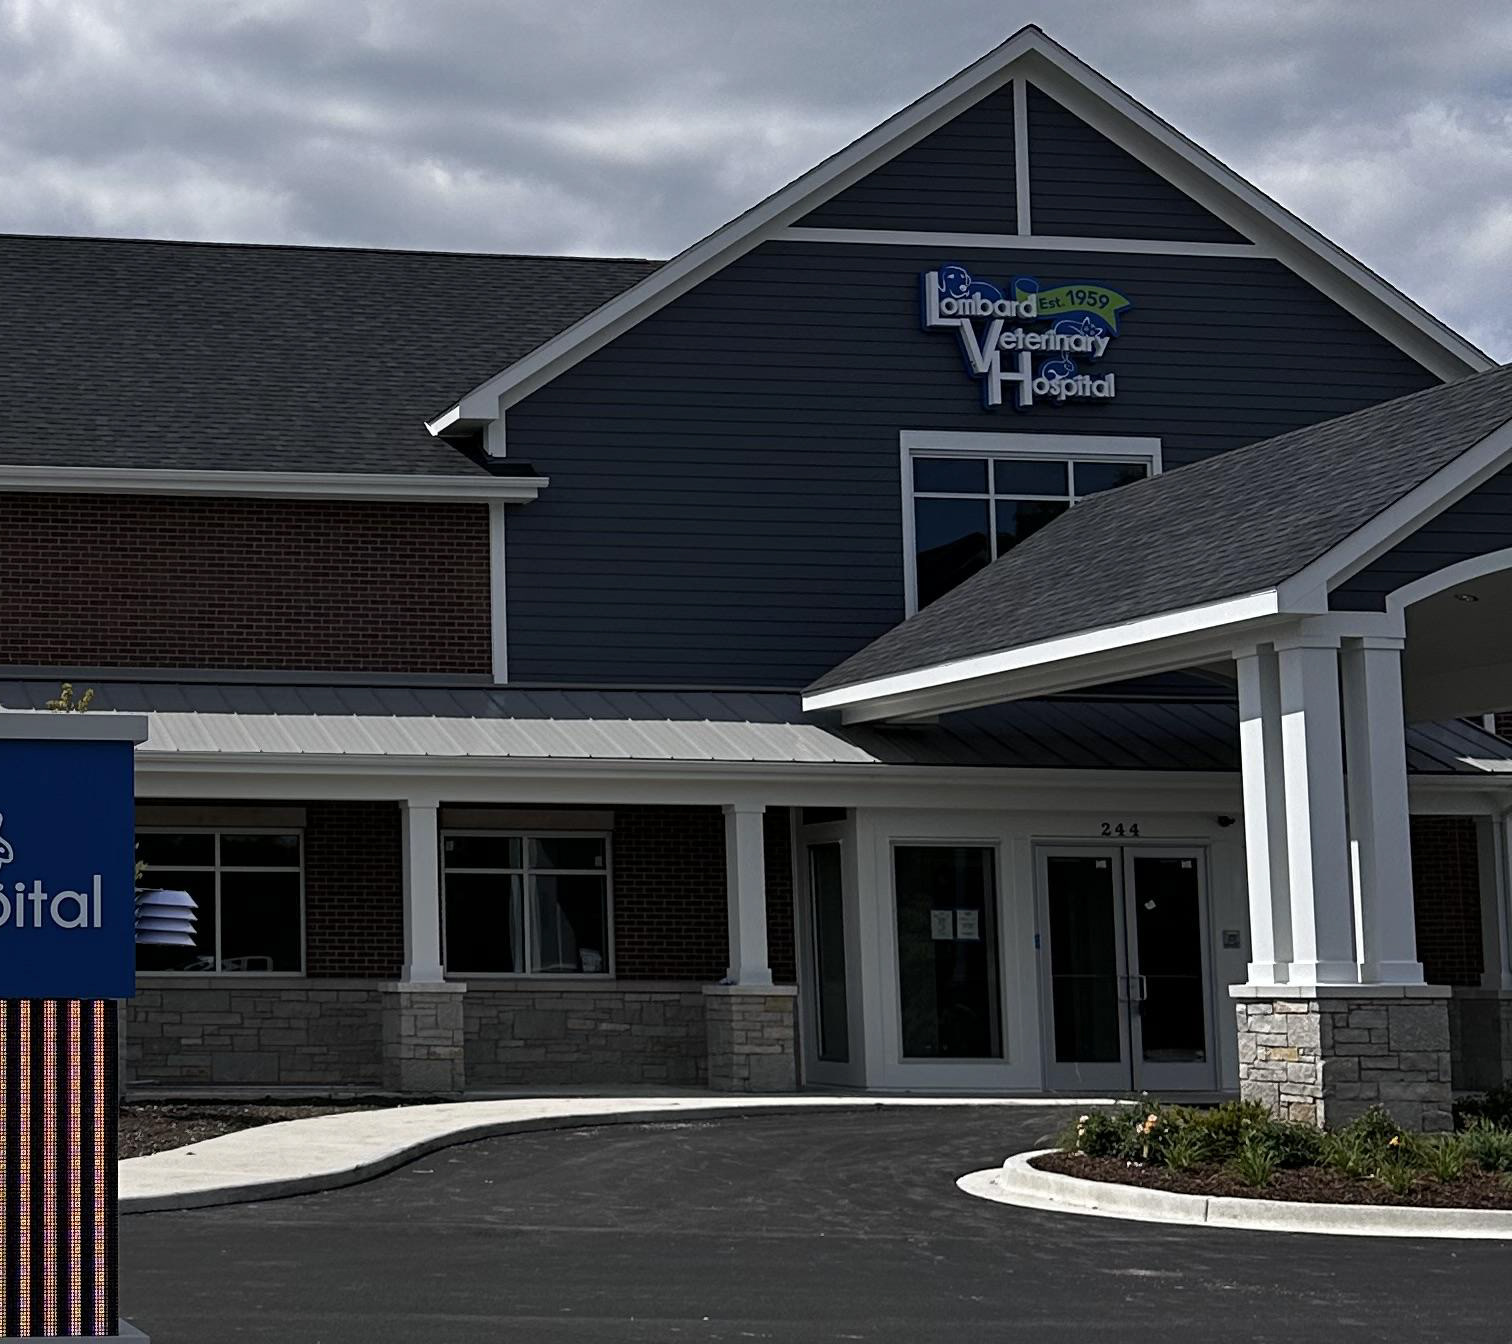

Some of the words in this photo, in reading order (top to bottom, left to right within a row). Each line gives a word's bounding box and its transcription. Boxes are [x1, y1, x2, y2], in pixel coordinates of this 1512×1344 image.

[925, 271, 1037, 327] Lombard
[1039, 297, 1065, 310] Est.
[1065, 289, 1110, 310] 1959
[960, 318, 1110, 374] Veterinary
[988, 350, 1116, 407] Hospital
[1100, 822, 1140, 837] 244
